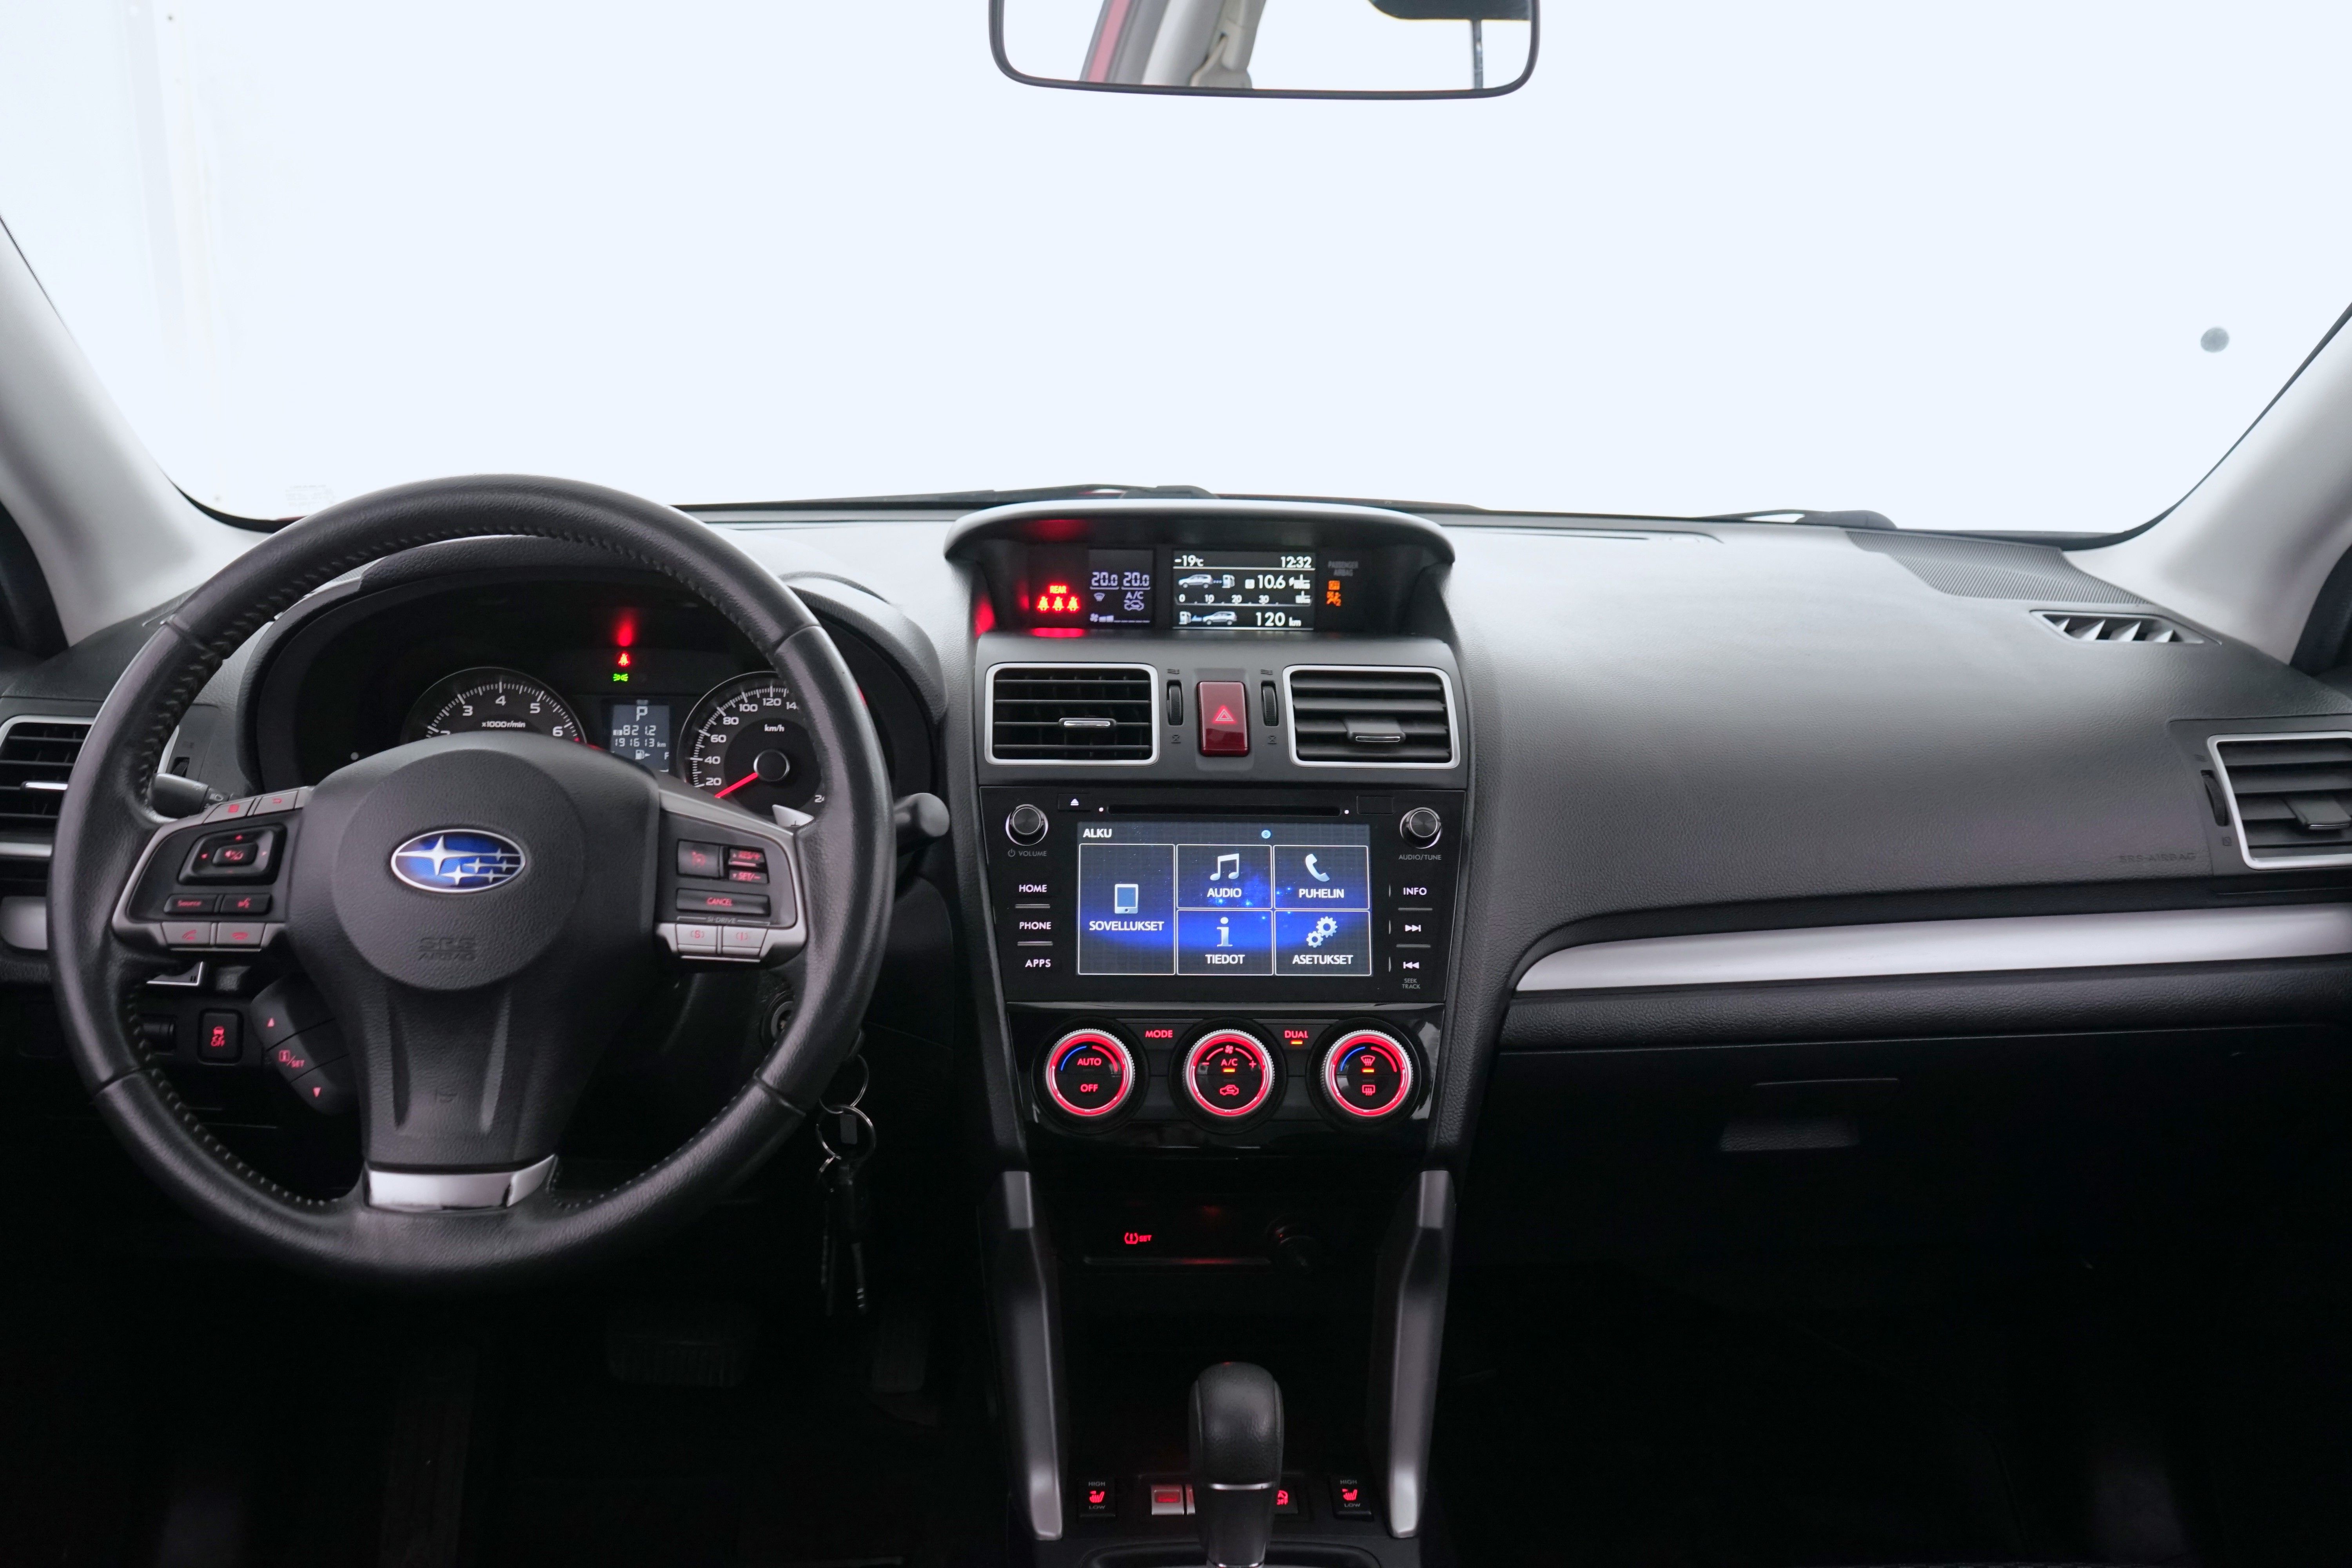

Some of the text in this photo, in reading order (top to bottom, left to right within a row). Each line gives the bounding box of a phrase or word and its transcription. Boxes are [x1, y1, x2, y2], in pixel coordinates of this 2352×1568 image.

[1280, 556, 1312, 568] 12:32
[1091, 572, 1118, 586] 20.0
[1123, 572, 1150, 586] 20.0
[1257, 574, 1286, 589] 10.6
[1125, 591, 1144, 600] A/C
[1205, 594, 1215, 603] 10
[1231, 594, 1242, 603] 20
[1259, 595, 1269, 603] 30
[1256, 612, 1286, 626] 120
[495, 695, 506, 706] 4
[762, 698, 782, 706] 120
[462, 705, 473, 716] 3
[530, 703, 541, 713] 5
[739, 704, 758, 712] 100
[786, 702, 800, 710] 14
[636, 706, 648, 721] P
[723, 717, 739, 725] 80
[552, 726, 563, 737] 6
[764, 724, 784, 732] km/h
[710, 734, 727, 743] 60
[704, 756, 721, 764] 40
[706, 777, 722, 786] 20
[1083, 828, 1112, 838] ALKU
[1019, 884, 1048, 893] HOME
[1207, 887, 1242, 898] AUDIO
[1298, 888, 1345, 898] PUHELIN
[1403, 887, 1427, 896] INFO
[706, 897, 733, 907] CANCEL
[1019, 922, 1052, 930] PHONE
[1089, 920, 1165, 931] SOVELLUKSET
[1025, 959, 1051, 968] APPS
[1205, 954, 1245, 965] TIEDOT
[1292, 954, 1354, 965] ASETUKSET
[1145, 1029, 1173, 1038] MODE
[1284, 1030, 1308, 1039] DUAL
[1077, 1058, 1102, 1066] AUTO
[1221, 1058, 1238, 1067] A/C
[1080, 1084, 1099, 1093] OFF
